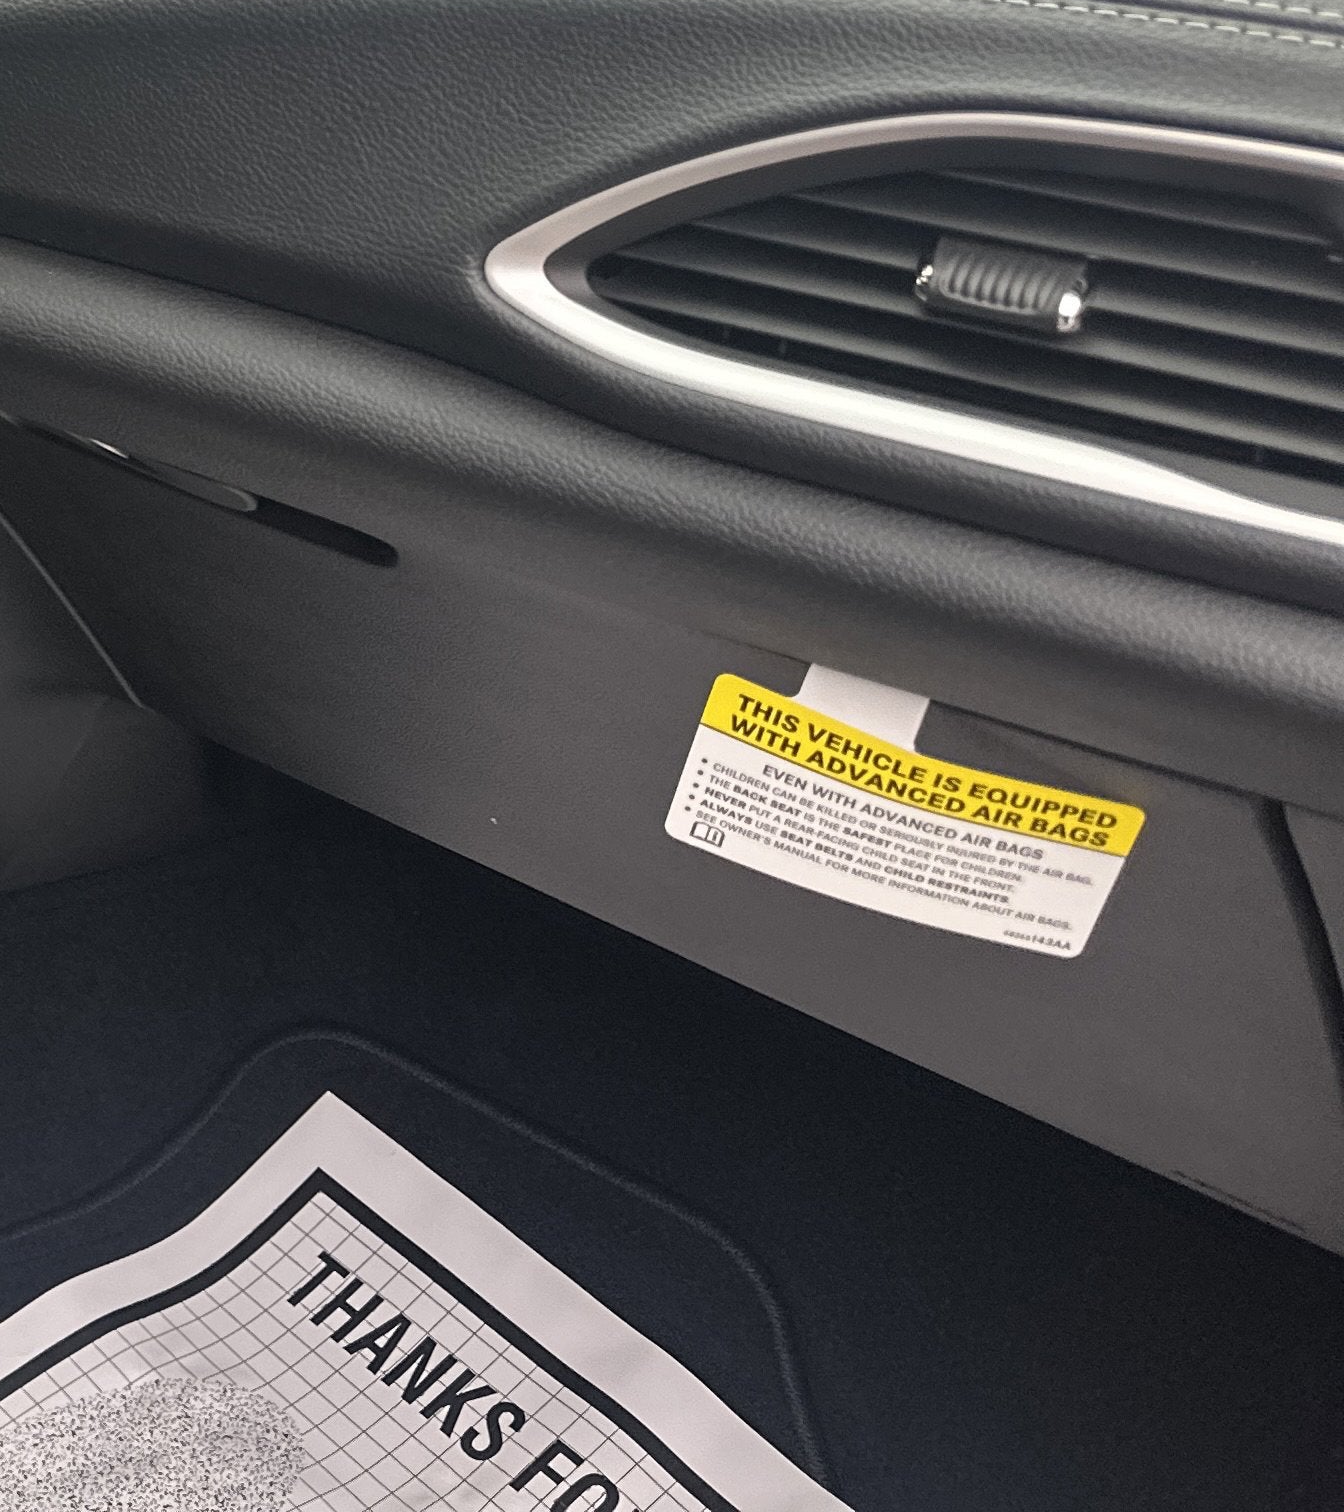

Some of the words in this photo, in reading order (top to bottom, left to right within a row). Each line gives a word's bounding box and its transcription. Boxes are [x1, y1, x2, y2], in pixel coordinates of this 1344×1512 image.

[713, 762, 771, 792] CHILDREN
[772, 786, 797, 803] CAN
[799, 796, 815, 809] BE
[816, 803, 858, 825] KILLED
[860, 817, 878, 831] OR
[879, 825, 945, 852] SERIOUSLY
[730, 714, 802, 758] WITH
[805, 749, 966, 814] ADVANCED
[971, 804, 1023, 829] AIR
[1029, 818, 1110, 848] BAGS
[738, 693, 801, 734] THIS
[807, 722, 928, 784] VEHICLE
[932, 773, 962, 793] IS
[967, 782, 1118, 829] EQUIPPED
[700, 799, 754, 826] ALWAYS
[755, 819, 779, 835] USE
[779, 829, 813, 848] SEAT
[814, 842, 854, 862] BELTS
[854, 856, 882, 871] AND
[883, 865, 925, 884] CHILD
[704, 786, 748, 810] NEVER
[749, 804, 772, 819] PUT
[783, 818, 861, 853] REAR-FACING
[861, 846, 899, 864] CHILD
[900, 857, 930, 872] SEAT
[709, 774, 731, 789] THE
[733, 783, 768, 806] BACK
[770, 799, 803, 817] SEAT
[804, 811, 816, 822] IS
[818, 817, 841, 832] THE
[842, 826, 893, 849] SAFEST
[893, 842, 933, 861] PLACE
[762, 764, 808, 792] EVEN
[812, 783, 857, 810] WITH
[860, 803, 958, 840] ADVANCED
[960, 832, 992, 849] AIR
[995, 839, 1044, 860] BAGS
[695, 809, 718, 824] SEE
[719, 819, 772, 846] OWNER'S
[773, 840, 823, 865] MANUAL
[825, 858, 850, 873] FOR
[851, 867, 888, 885] MORE
[888, 878, 970, 908] INFORMATION
[972, 900, 1014, 918] ABOUT
[286, 1251, 526, 1461] THANKS
[511, 1438, 647, 1512] FO
